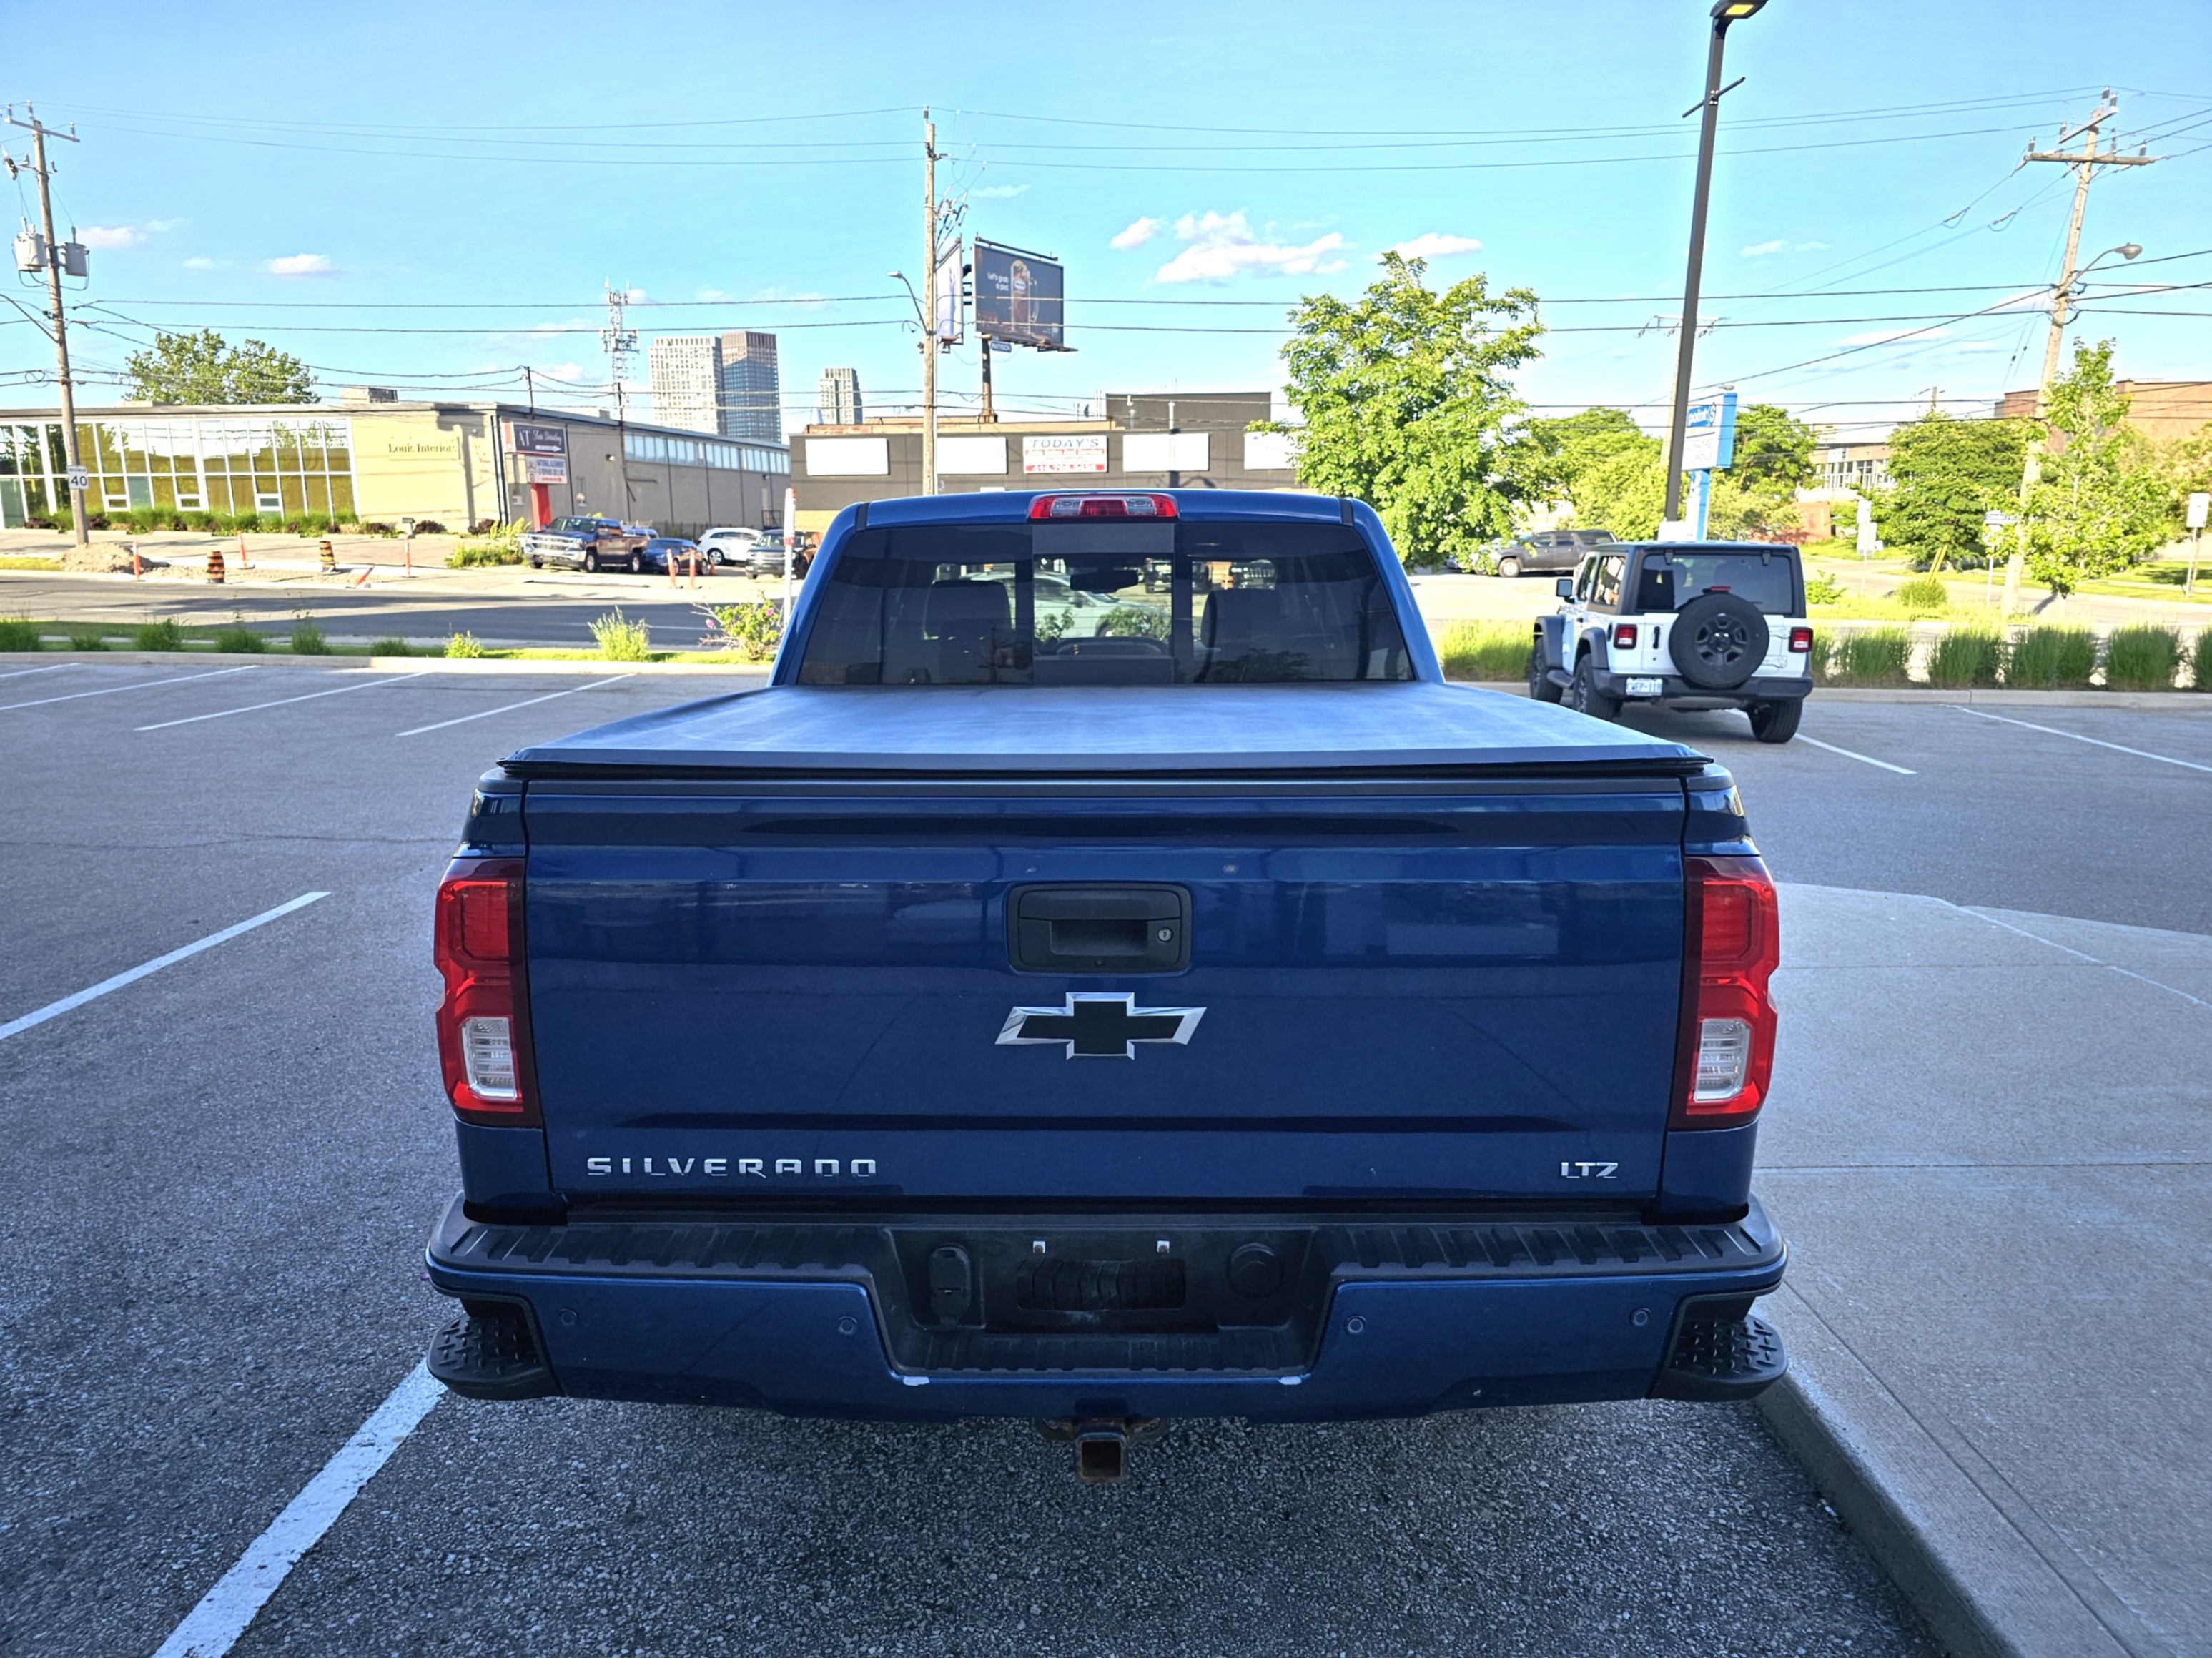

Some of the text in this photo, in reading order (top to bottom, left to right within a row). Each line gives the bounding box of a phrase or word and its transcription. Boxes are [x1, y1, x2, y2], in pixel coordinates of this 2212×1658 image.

[1031, 438, 1100, 448] TODAY'S
[71, 475, 87, 486] 40
[587, 1158, 877, 1178] SILVERADO
[1561, 1162, 1618, 1178] LTZ
